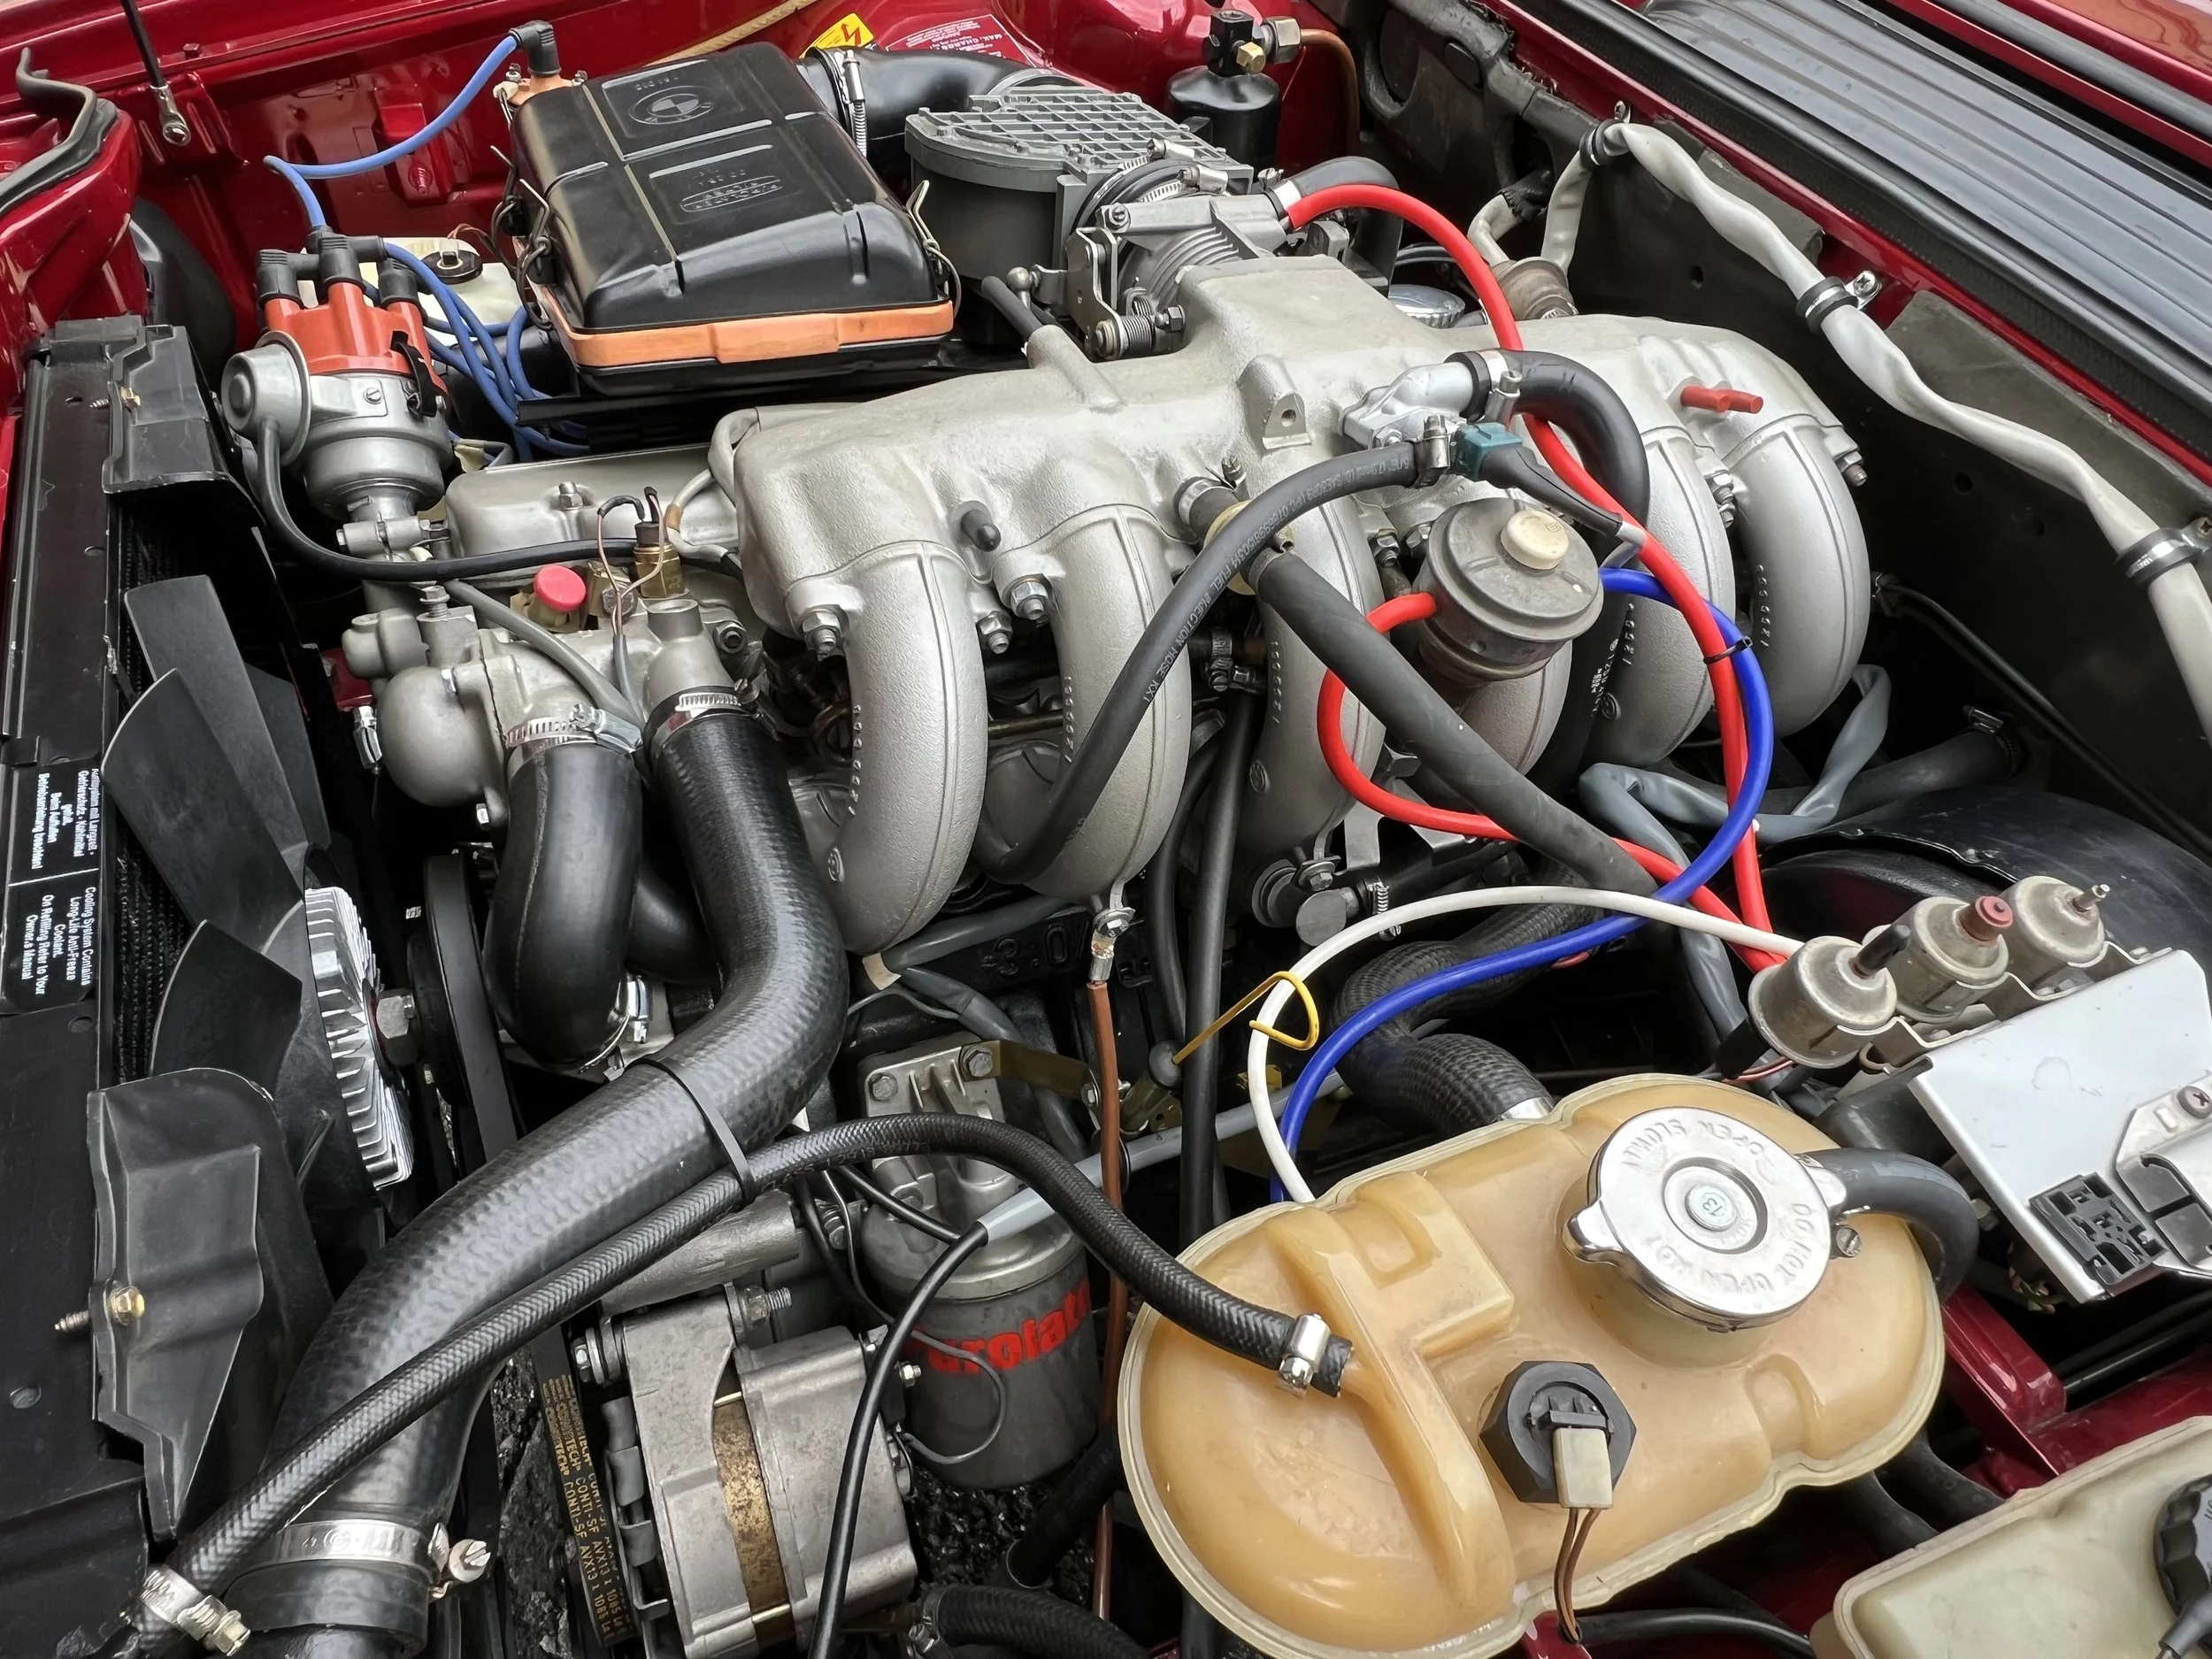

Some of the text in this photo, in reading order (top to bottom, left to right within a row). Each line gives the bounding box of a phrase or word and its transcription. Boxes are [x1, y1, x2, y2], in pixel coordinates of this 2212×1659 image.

[1209, 565, 1233, 591] FUEL
[1174, 592, 1213, 647] INJECTION
[1156, 646, 1179, 680] HOSE
[21, 949, 35, 979] Manual
[35, 895, 54, 995] On Refilling Refer to Your
[53, 924, 65, 957] Coolant.
[66, 897, 81, 980] Long-Life Anti-Freeze
[81, 887, 96, 986] Cooling System Contains
[562, 1481, 588, 1540] CONTI-SF
[579, 1543, 598, 1581] AVX13
[574, 1476, 600, 1535] CONTI-SF
[592, 1540, 611, 1576] AVX13
